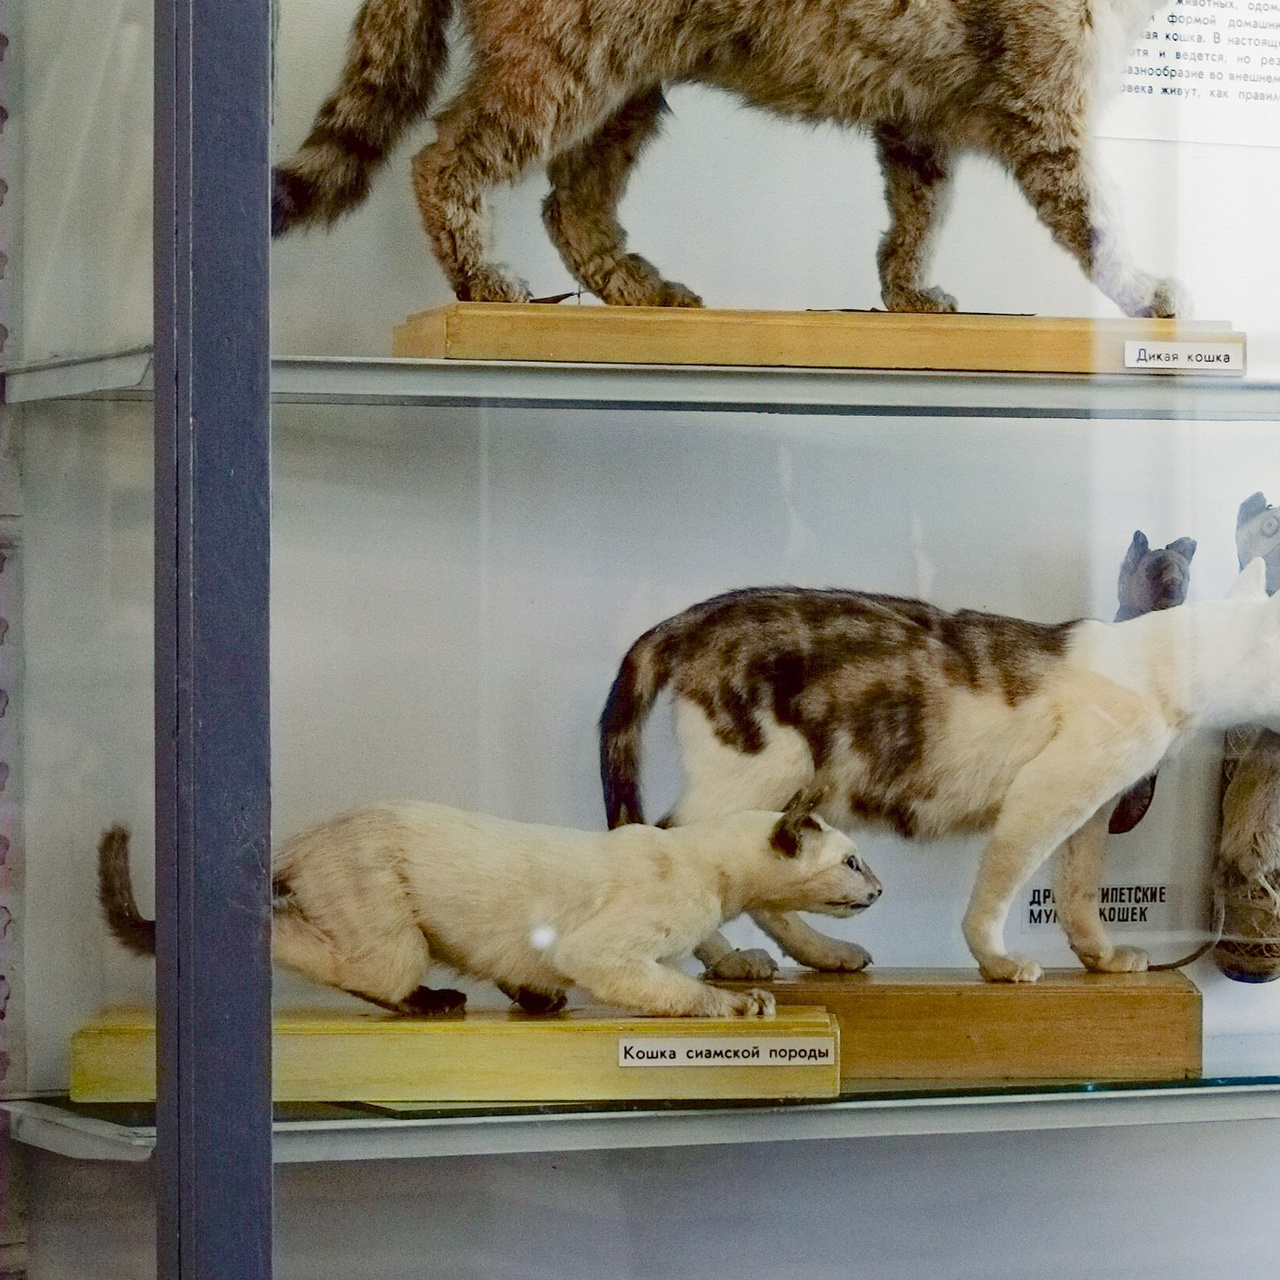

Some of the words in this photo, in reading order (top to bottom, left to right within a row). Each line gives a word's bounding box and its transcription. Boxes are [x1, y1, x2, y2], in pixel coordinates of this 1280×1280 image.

[1166, 11, 1217, 27] формой
[1164, 32, 1206, 44] кошка.
[1213, 31, 1221, 44] В
[1158, 49, 1167, 58] и
[1236, 55, 1251, 64] но
[1209, 71, 1224, 81] во
[1228, 73, 1280, 84] внешнем
[1160, 86, 1201, 99] живут,
[1209, 90, 1229, 99] как
[1136, 348, 1179, 363] Дикая
[1187, 353, 1231, 364] кошка
[1099, 907, 1148, 922] КОШЕК
[623, 1046, 676, 1060] Кошка
[685, 1046, 760, 1060] сиамской
[768, 1048, 830, 1061] породы
